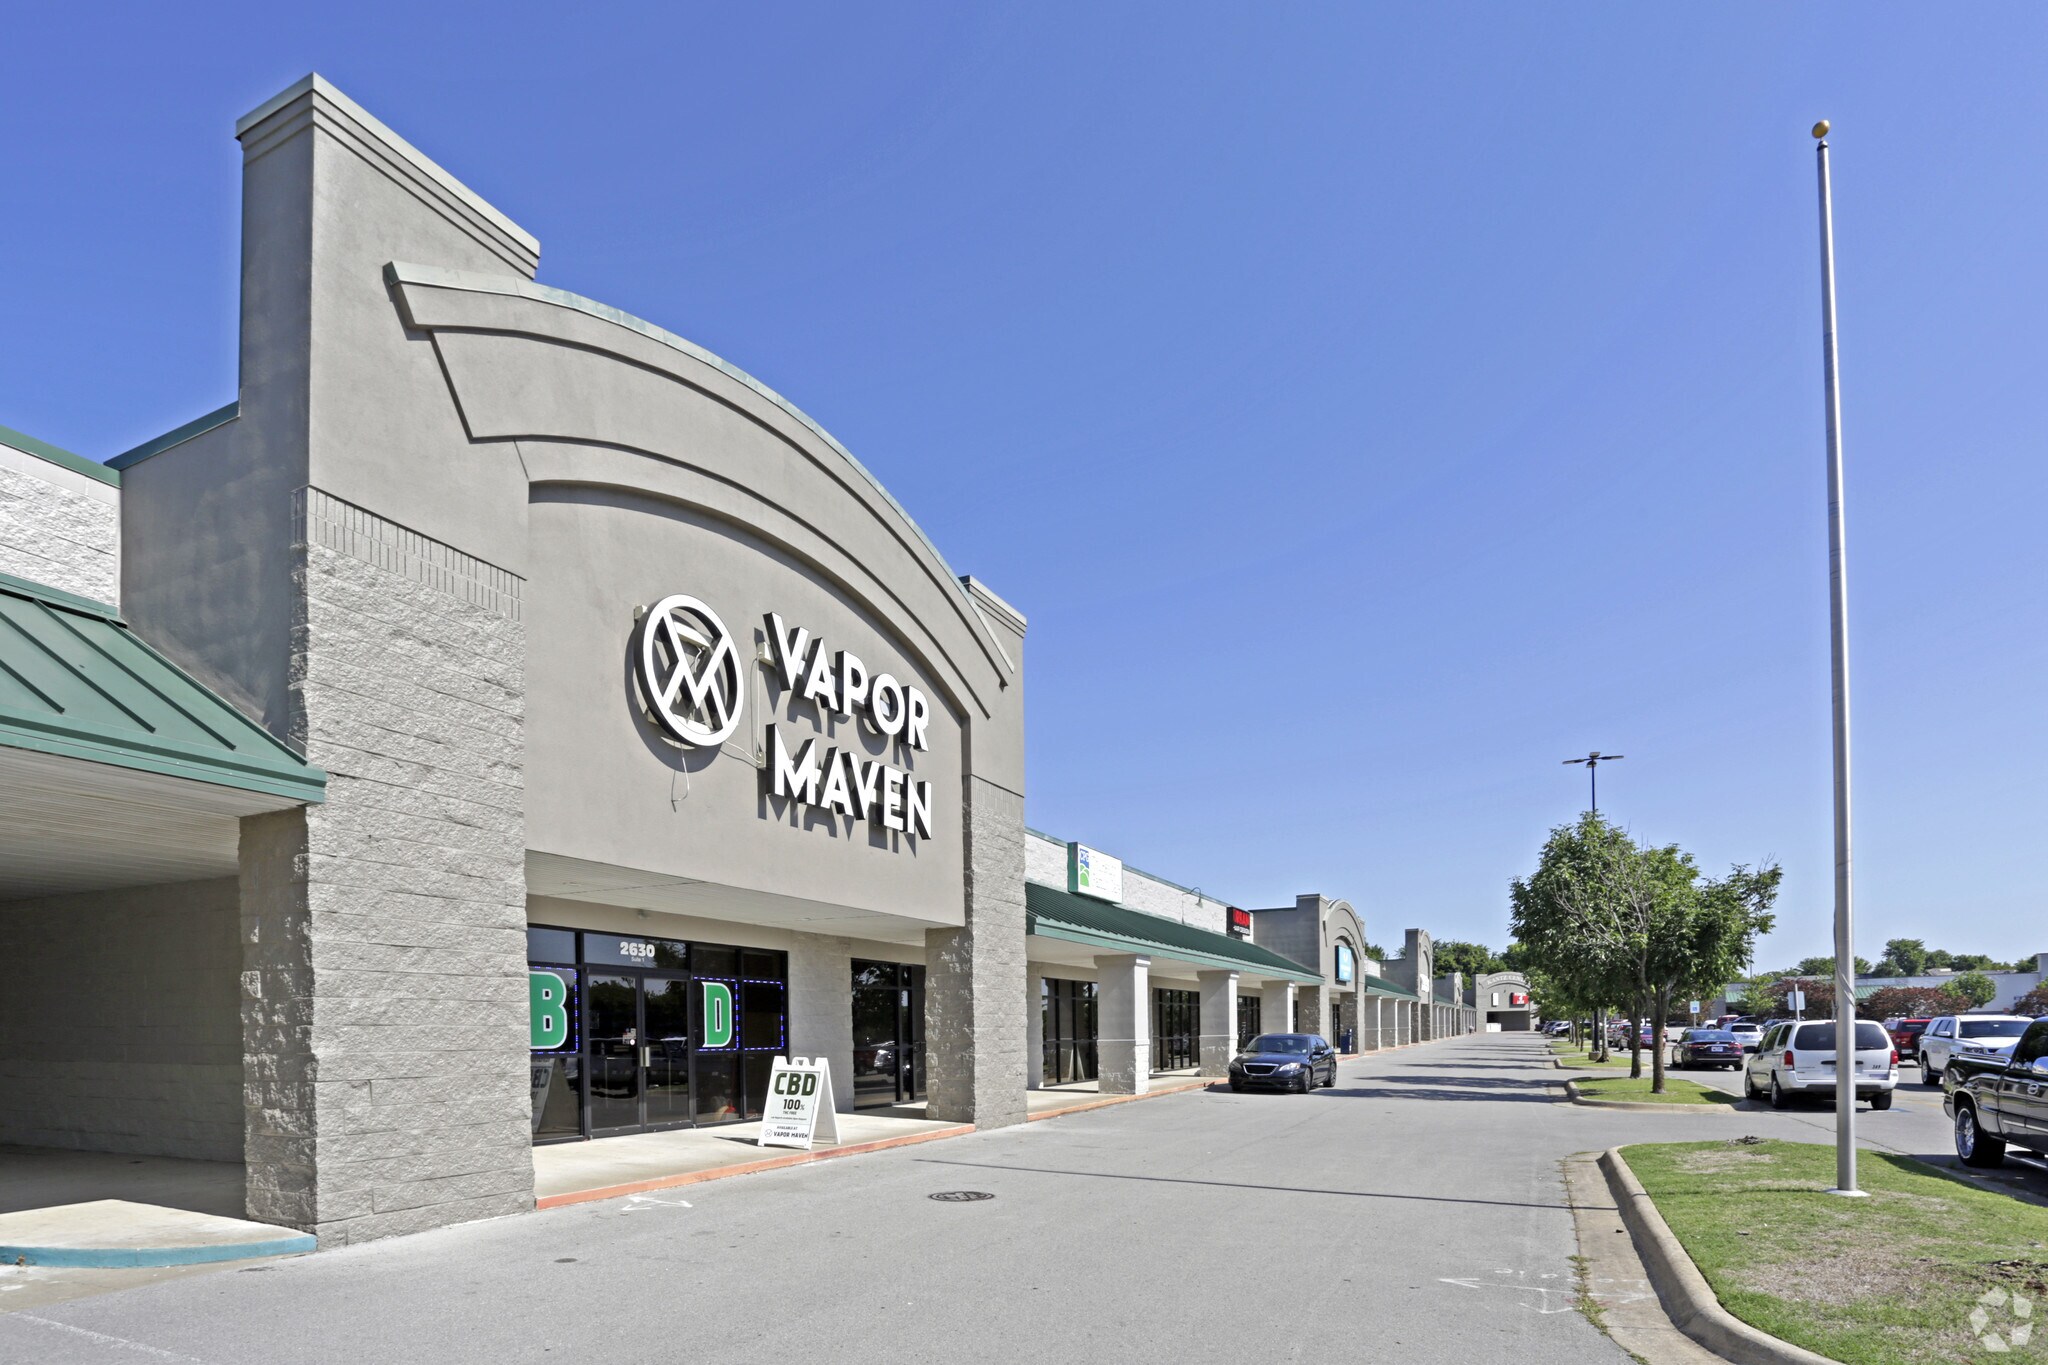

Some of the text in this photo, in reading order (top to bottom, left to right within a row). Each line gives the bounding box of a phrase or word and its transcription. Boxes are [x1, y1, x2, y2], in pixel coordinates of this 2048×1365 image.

[763, 611, 930, 752] VAPOR
[766, 723, 932, 840] MAVEN
[620, 941, 655, 957] 2630
[774, 1072, 817, 1096] CBD
